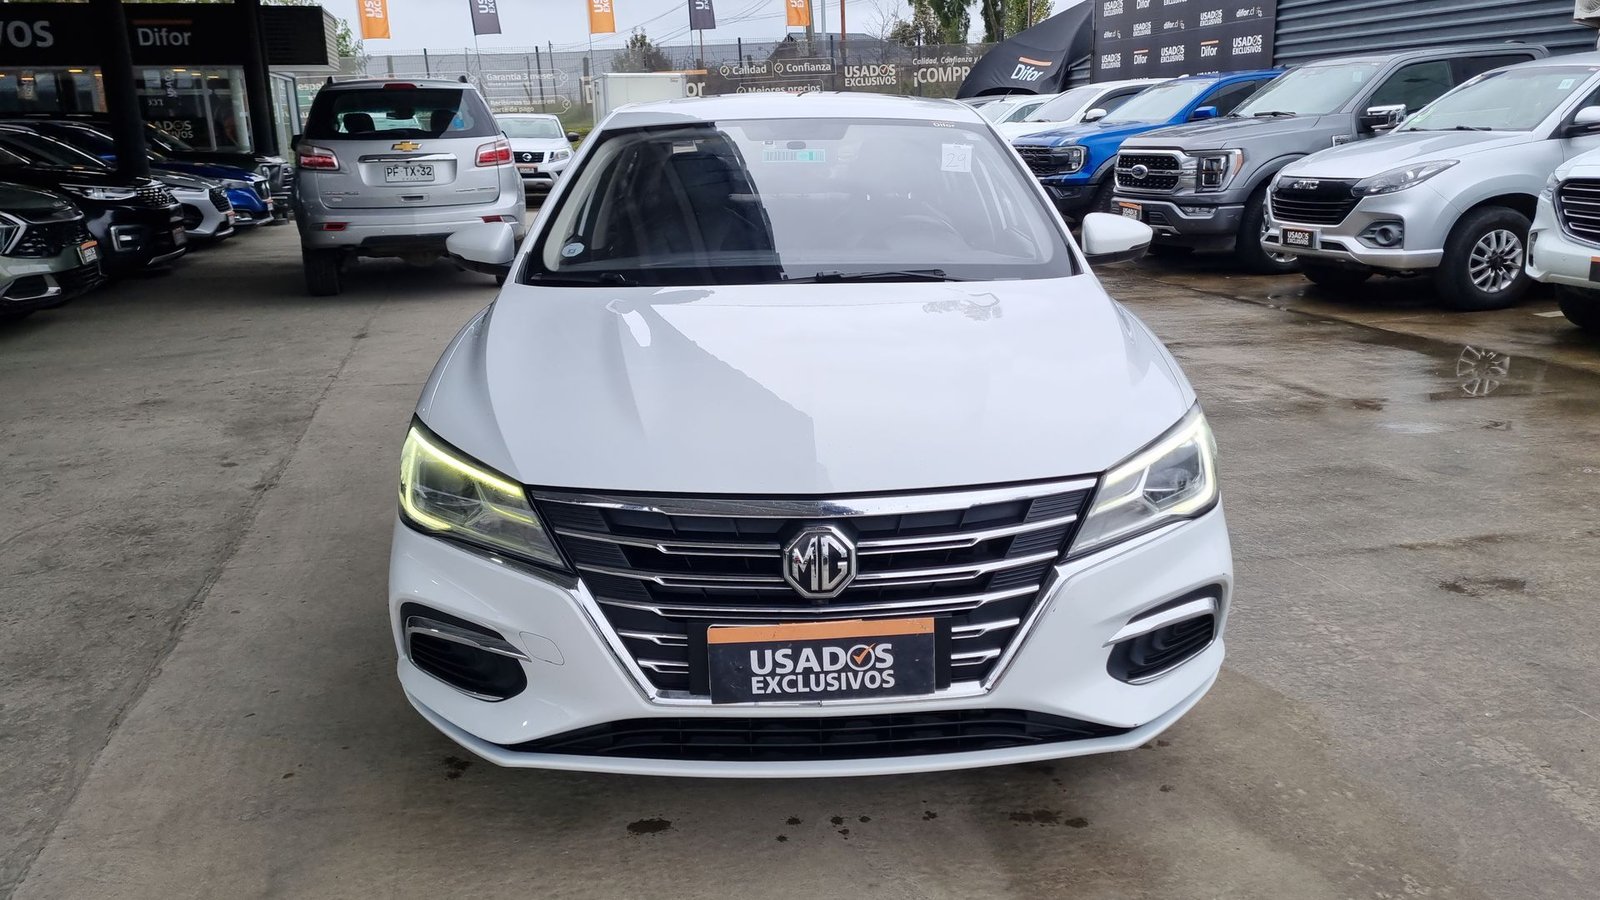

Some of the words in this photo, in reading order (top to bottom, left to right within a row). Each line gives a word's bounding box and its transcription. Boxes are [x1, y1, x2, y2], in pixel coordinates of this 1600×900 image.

[1200, 10, 1223, 21] USADOS
[1133, 22, 1152, 32] USADOS
[0, 22, 54, 48] OS
[137, 27, 191, 46] Difor
[1233, 35, 1263, 47] USADOS
[1161, 45, 1185, 56] USADOS
[1200, 45, 1218, 58] Difor
[1232, 45, 1262, 55] EXCLUSIVOS
[1101, 53, 1121, 63] USADOS
[1133, 54, 1148, 65] Difor
[732, 65, 767, 75] Calidad
[786, 63, 832, 73] Confianza
[844, 64, 896, 77] USADOS
[1010, 63, 1044, 82] Difor
[845, 76, 897, 87] EXCLUSIVOS
[386, 167, 400, 177] PF
[404, 167, 417, 177] TX
[420, 167, 432, 176] 32
[1287, 231, 1309, 240] USADOS
[791, 535, 848, 591] MG
[750, 643, 894, 674] USADOS
[752, 669, 896, 694] EXCLUSIVOS
